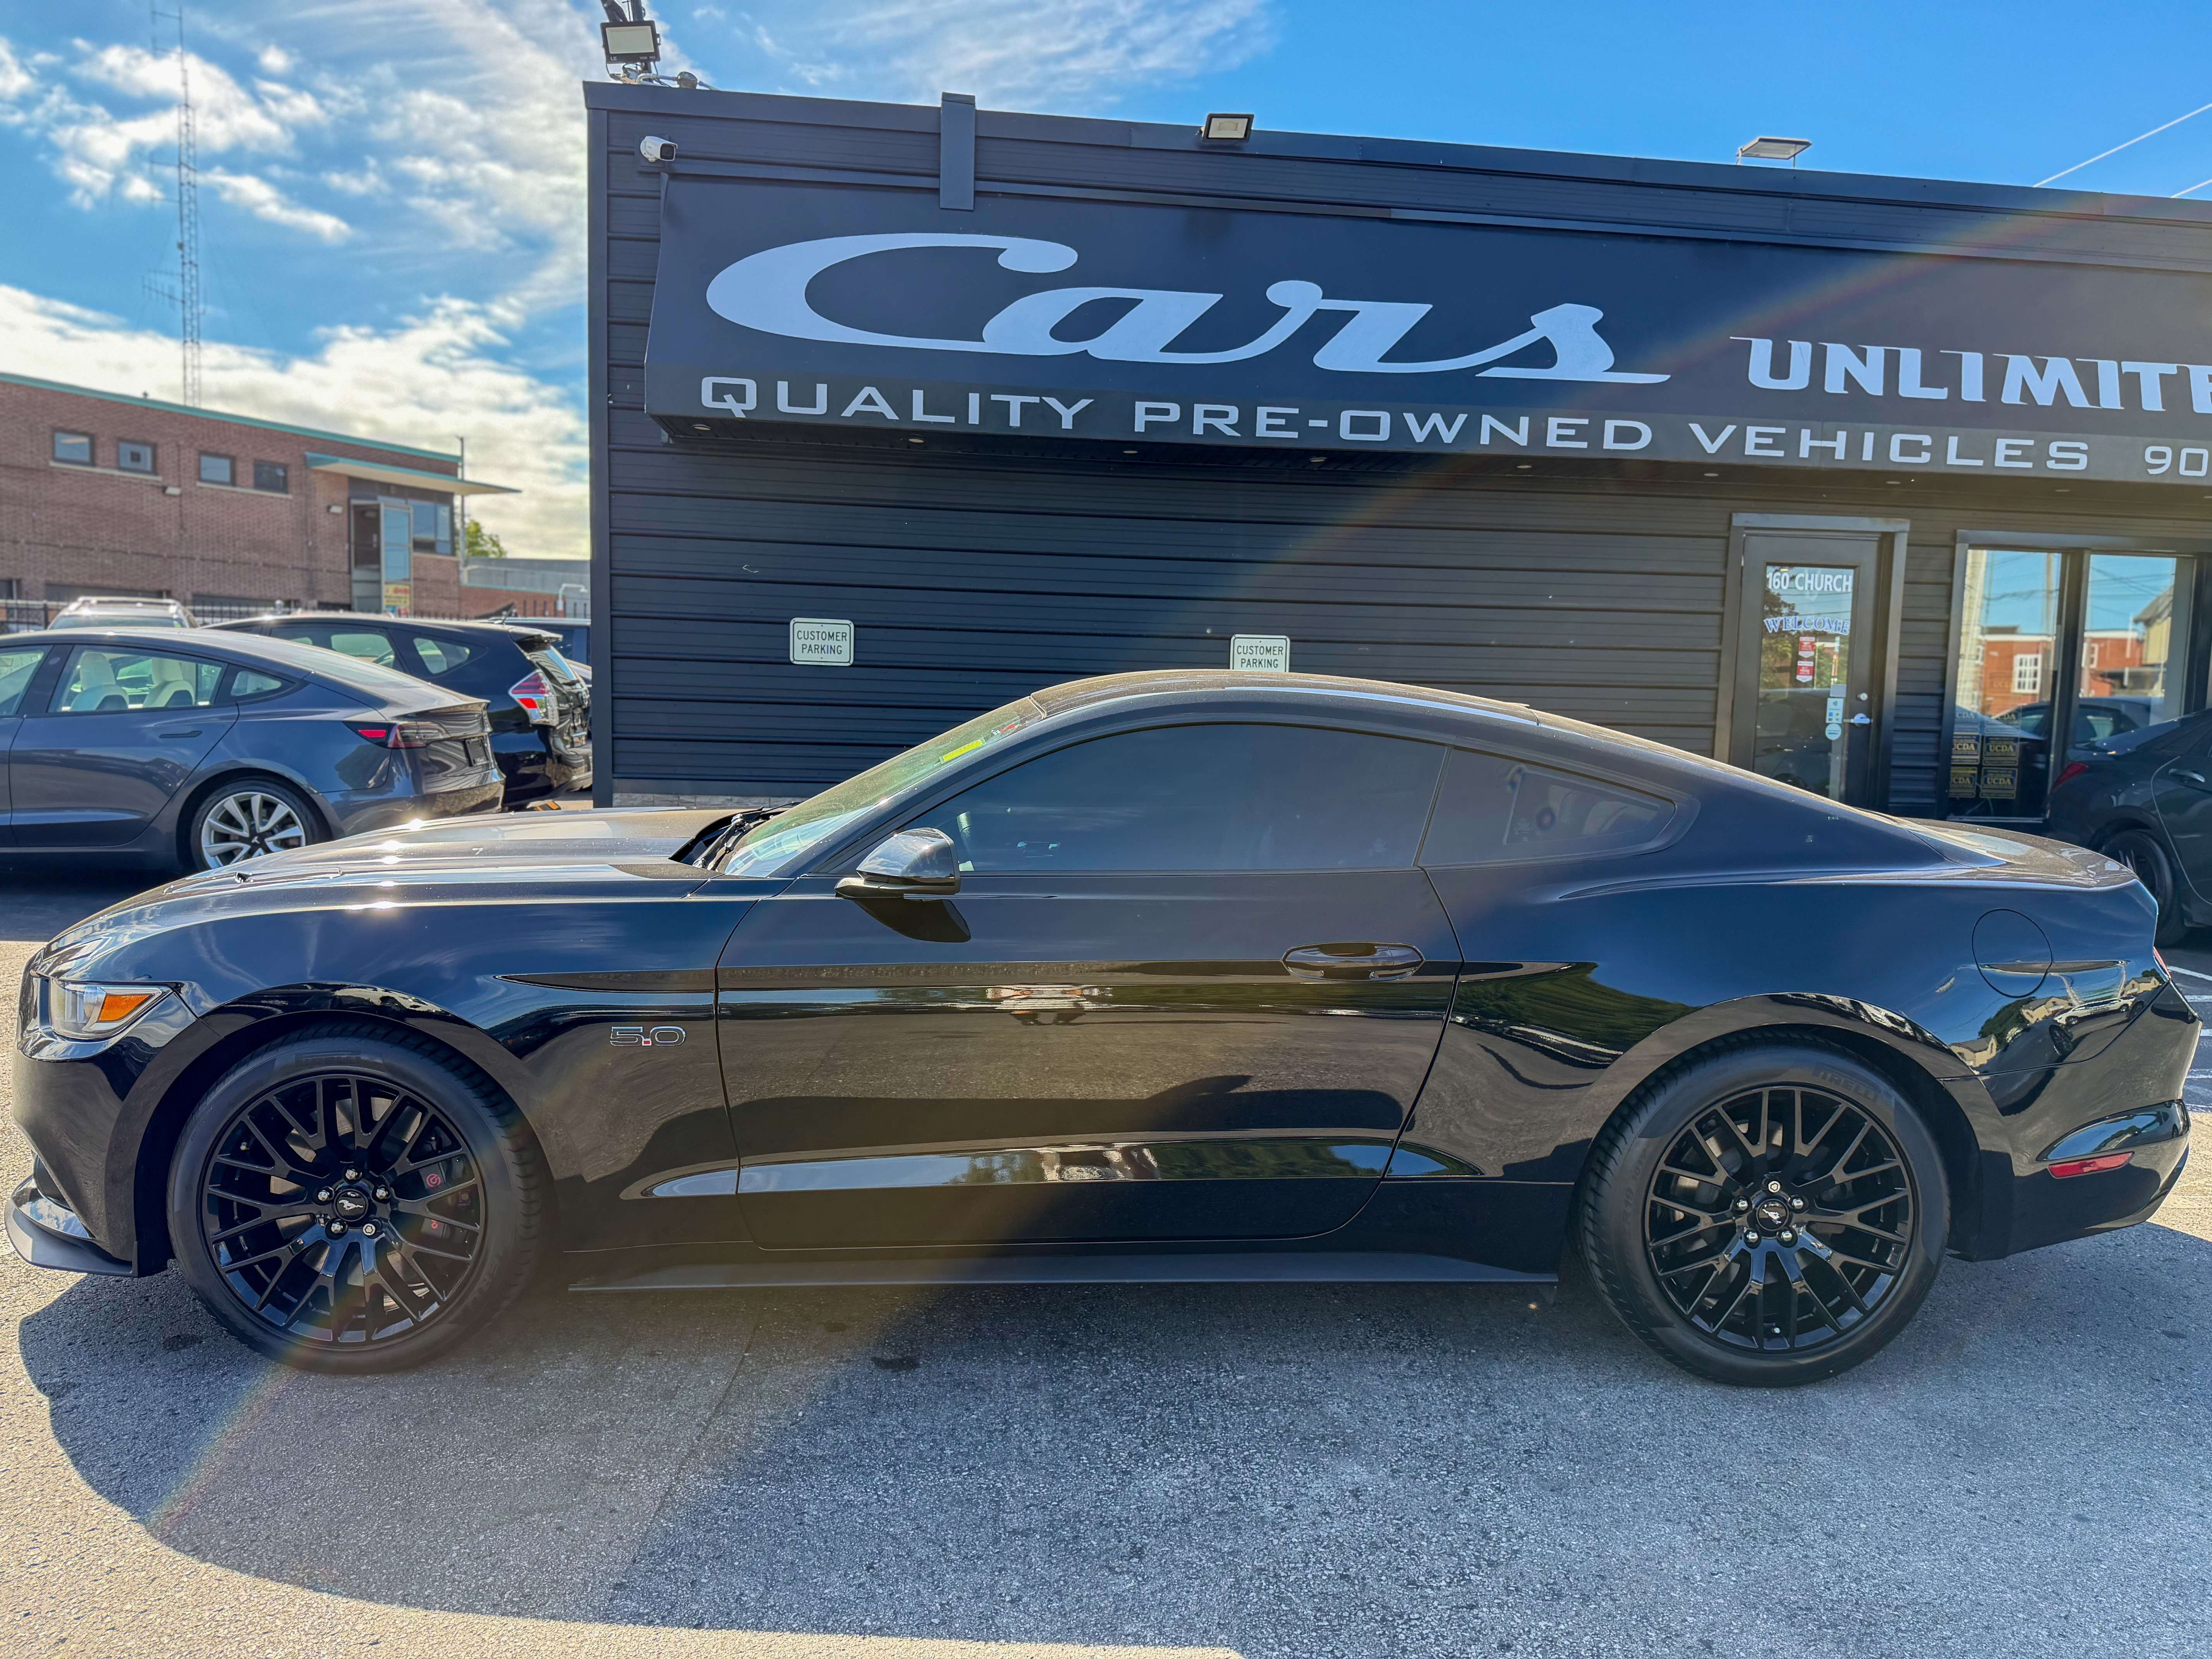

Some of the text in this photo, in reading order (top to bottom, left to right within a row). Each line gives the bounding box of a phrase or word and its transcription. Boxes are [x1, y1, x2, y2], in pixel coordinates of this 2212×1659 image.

[706, 232, 1671, 384] Cars
[701, 376, 2209, 477] QUALITY PRE-OWNED VEHICLES 90
[1767, 572, 1853, 592] 160 CHURCH
[1764, 616, 1850, 635] WELCOME
[797, 630, 847, 642] CUSTOMER
[802, 644, 842, 654] PARKING
[1237, 645, 1283, 656] CUSTOMER
[1240, 658, 1278, 668] PARKING
[1987, 777, 2011, 785] UCDA
[610, 1026, 686, 1046] 5.0
